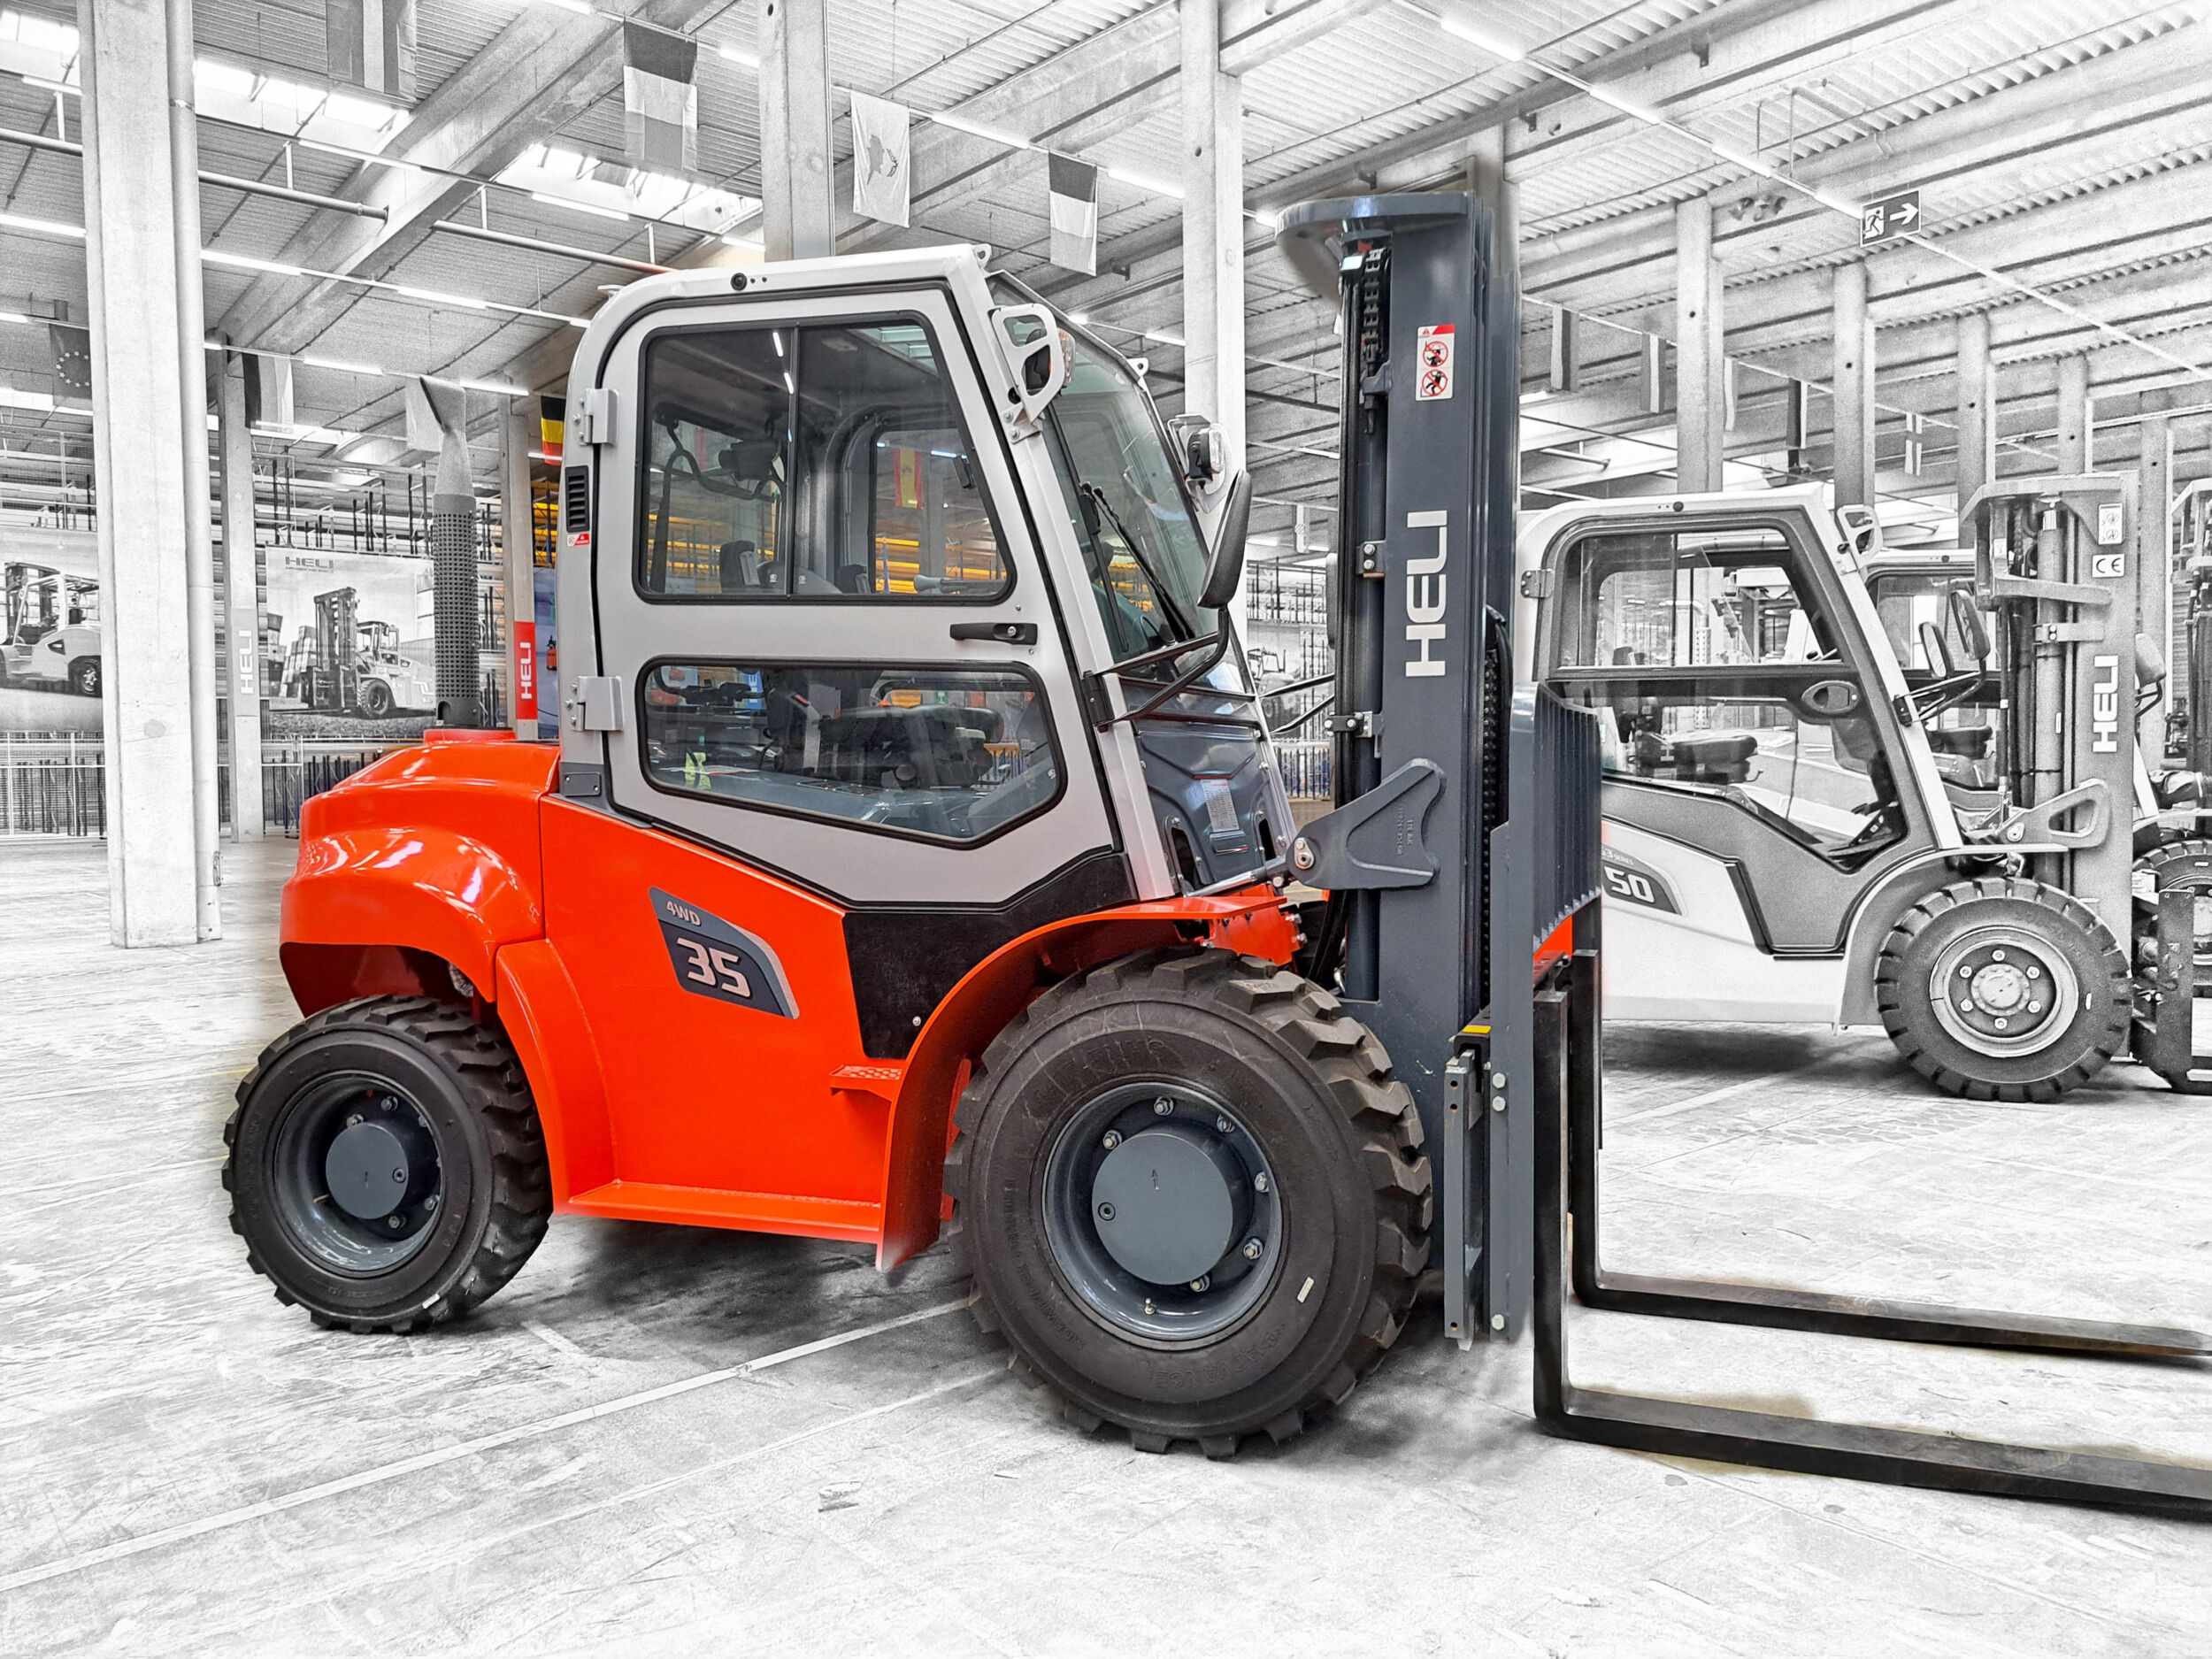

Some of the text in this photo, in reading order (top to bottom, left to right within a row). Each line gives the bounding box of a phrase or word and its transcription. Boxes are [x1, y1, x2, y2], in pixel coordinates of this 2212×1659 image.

[285, 557, 334, 569] HELI
[2096, 557, 2122, 574] CE
[1405, 510, 1448, 678] HELI
[238, 629, 254, 695] HELI
[519, 641, 533, 700] HELI
[2092, 655, 2119, 753] HELI
[666, 900, 702, 926] 4WD
[1603, 866, 1655, 903] 50
[676, 937, 751, 998] 35
